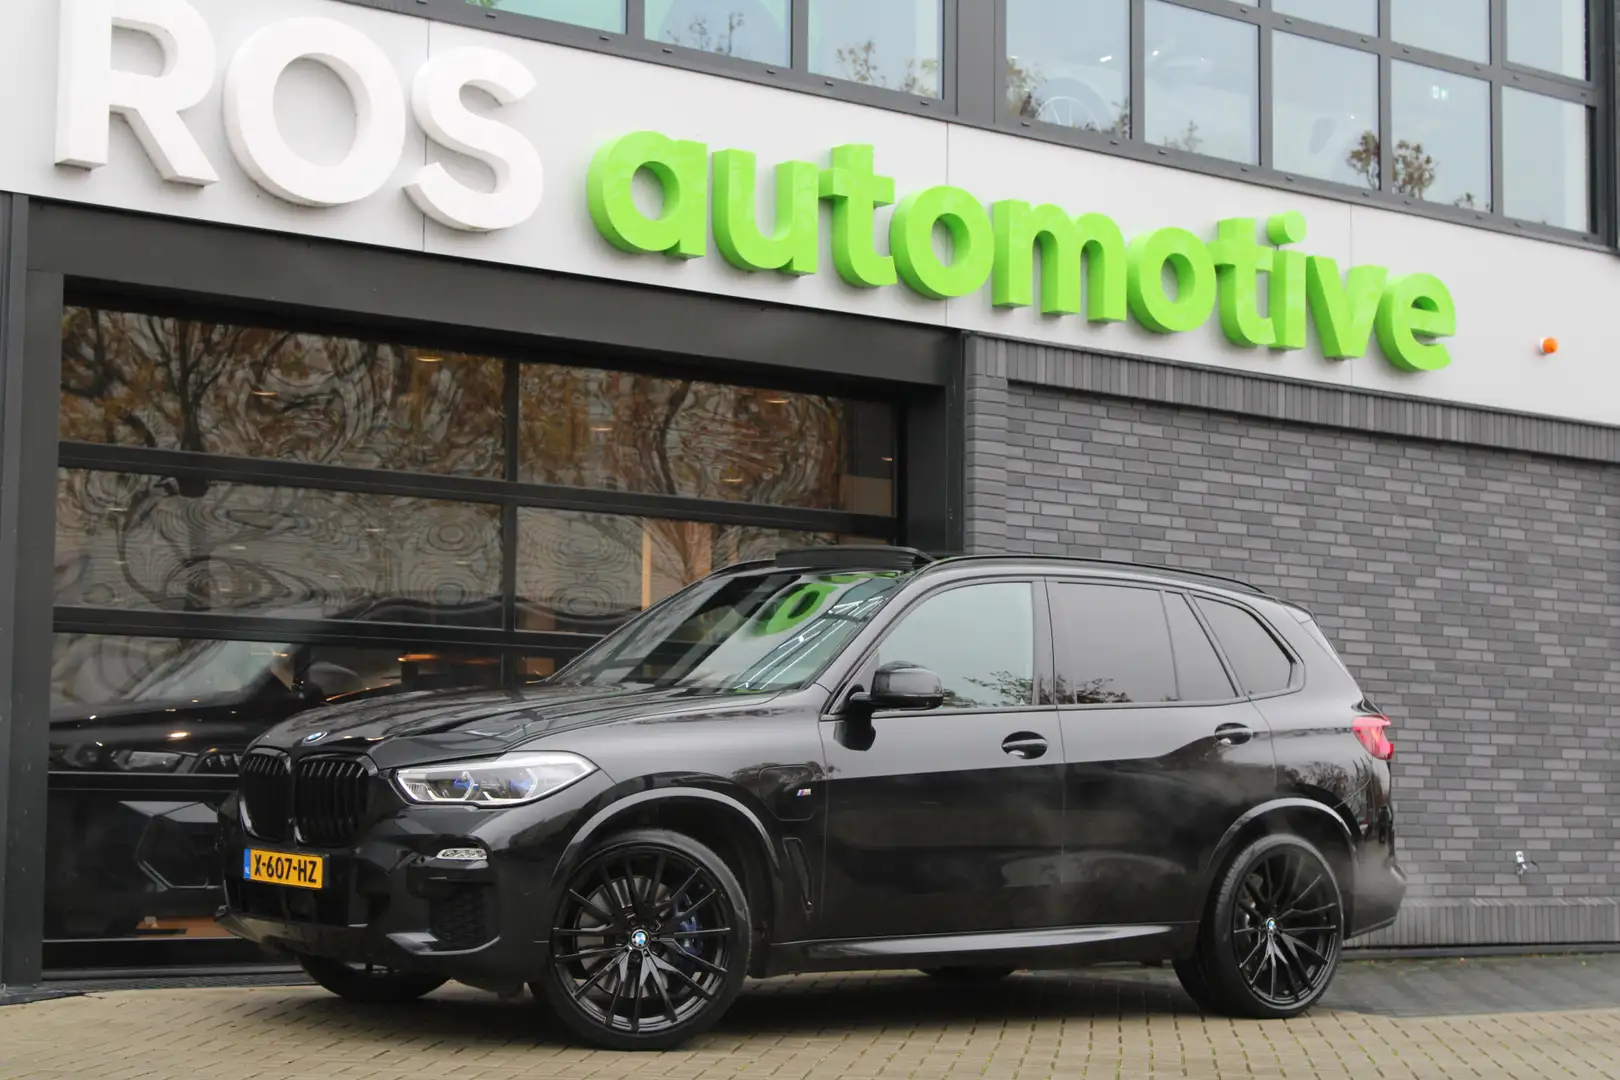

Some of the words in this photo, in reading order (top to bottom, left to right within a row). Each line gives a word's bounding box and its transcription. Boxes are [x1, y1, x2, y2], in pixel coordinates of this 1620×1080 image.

[55, 0, 543, 232] ROS
[587, 130, 1457, 372] automotive
[254, 854, 317, 884] X-607-HZ
